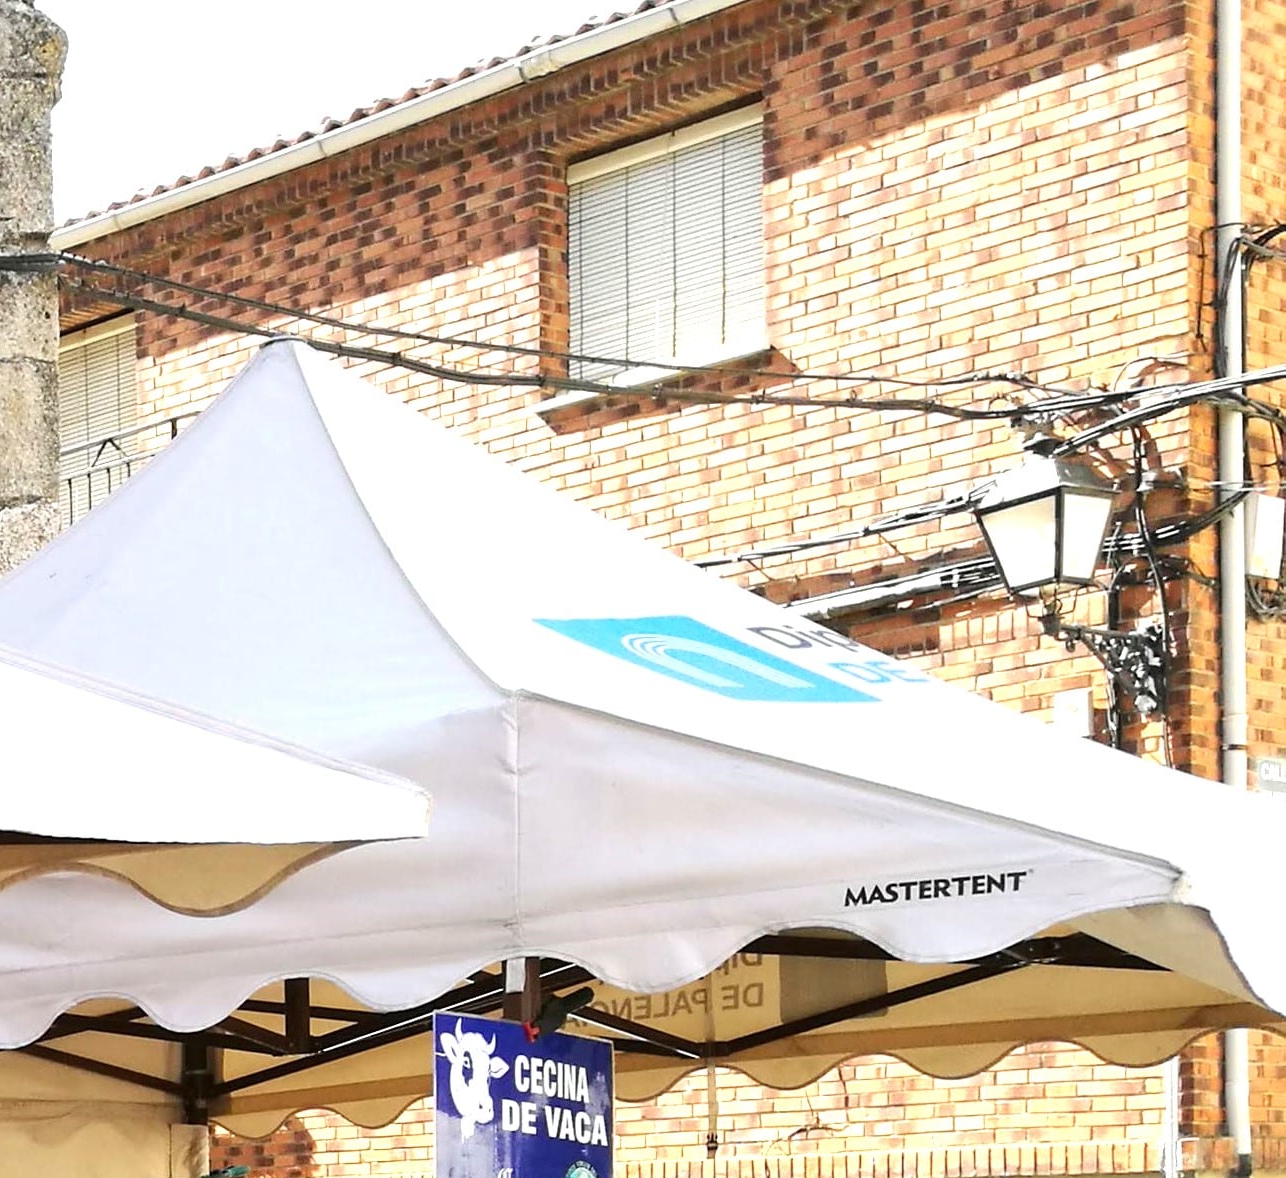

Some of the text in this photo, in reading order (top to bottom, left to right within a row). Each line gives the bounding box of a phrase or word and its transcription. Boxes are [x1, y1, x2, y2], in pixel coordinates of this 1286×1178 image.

[844, 871, 1027, 907] MASTERTENT
[514, 1054, 590, 1104] CECINA
[501, 1099, 609, 1147] DE VACA
